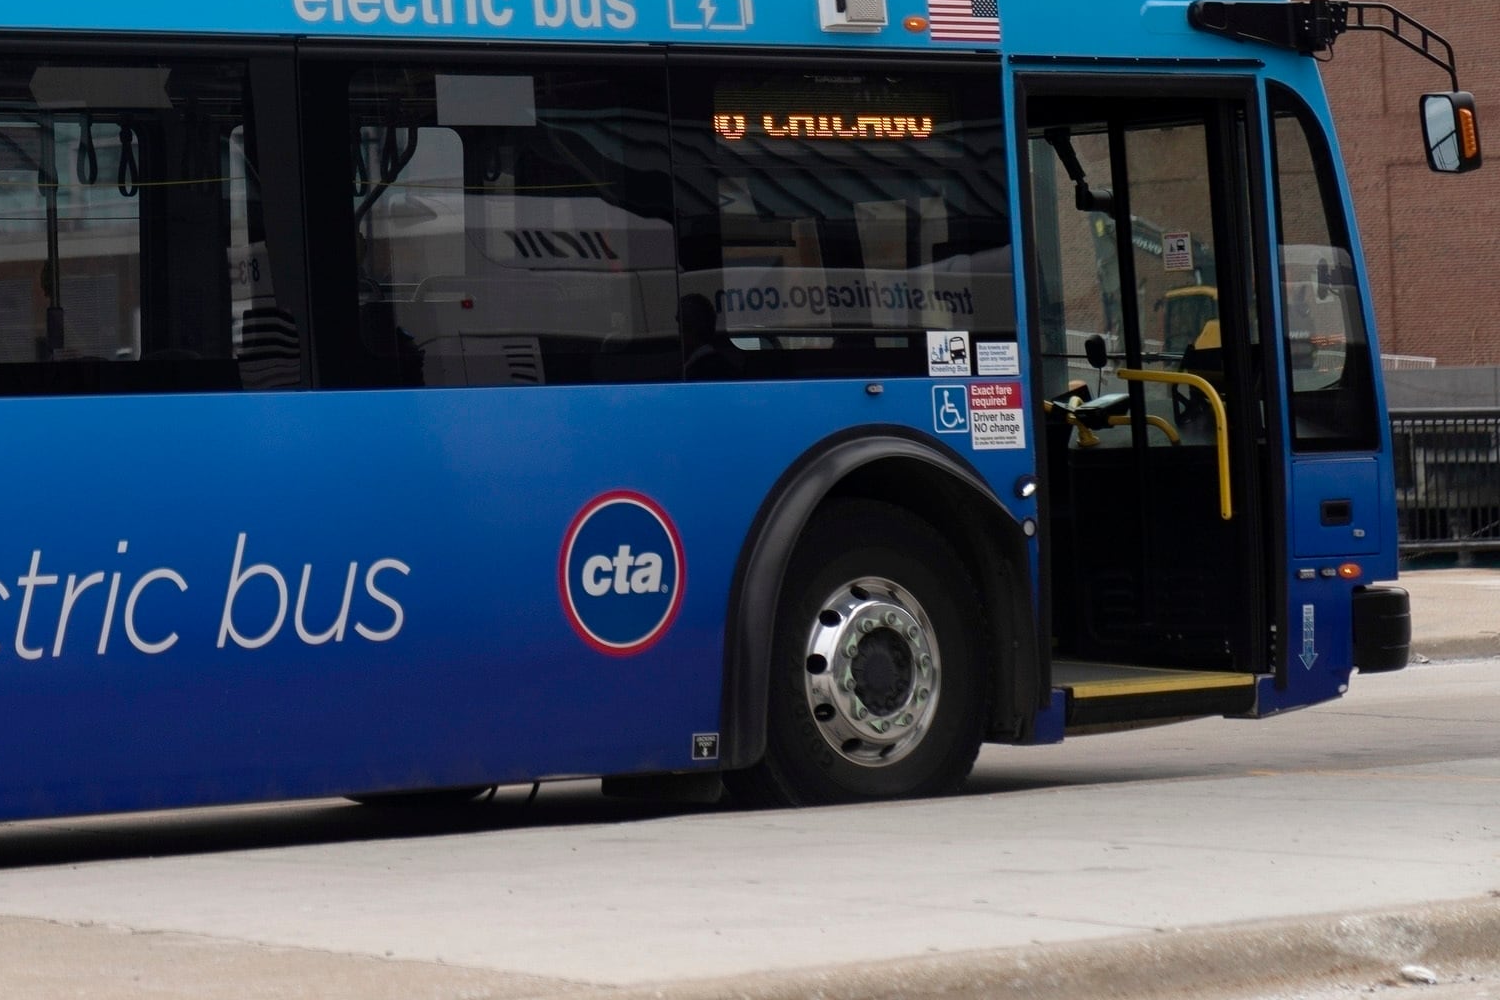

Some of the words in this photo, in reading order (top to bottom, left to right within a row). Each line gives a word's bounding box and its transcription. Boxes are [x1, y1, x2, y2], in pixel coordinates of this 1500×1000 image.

[971, 385, 994, 395] Exact
[996, 385, 1012, 395] fare
[972, 396, 1007, 408] required
[973, 412, 998, 422] Driver
[1000, 412, 1015, 421] has
[974, 424, 987, 433] NO
[990, 423, 1020, 434] change
[582, 545, 664, 597] cta
[216, 532, 412, 650] bus
